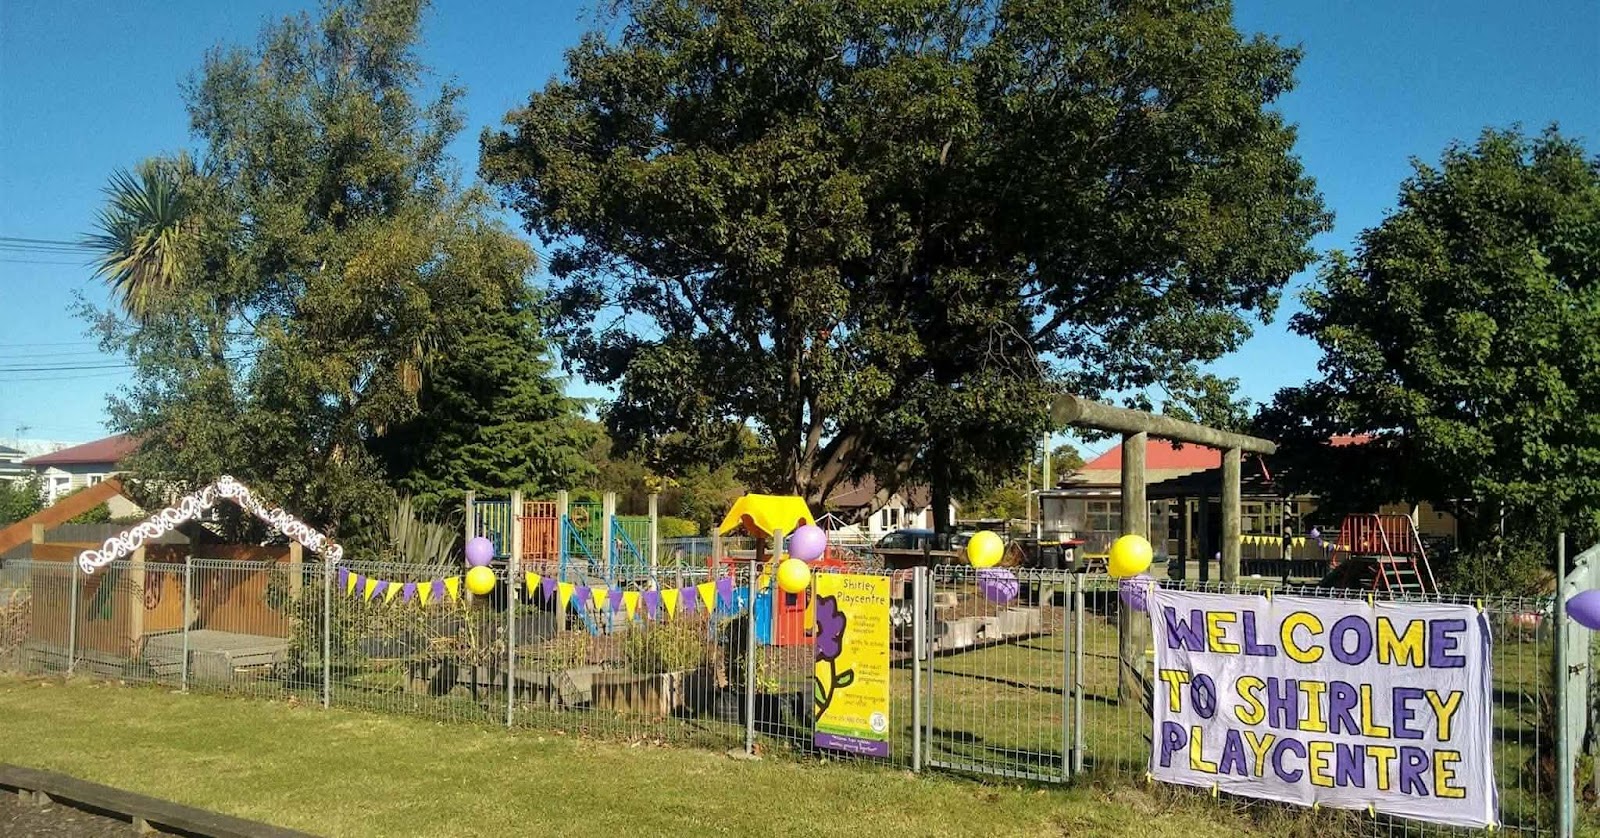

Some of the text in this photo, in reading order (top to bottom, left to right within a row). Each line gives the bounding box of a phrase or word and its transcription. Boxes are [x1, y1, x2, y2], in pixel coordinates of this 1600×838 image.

[837, 591, 886, 606] Playcentre
[843, 579, 876, 594] Shirley
[1164, 606, 1467, 668] WELCOME
[1159, 668, 1464, 742] TO SHIRLEY
[1159, 721, 1467, 799] PLAYCENTRE
